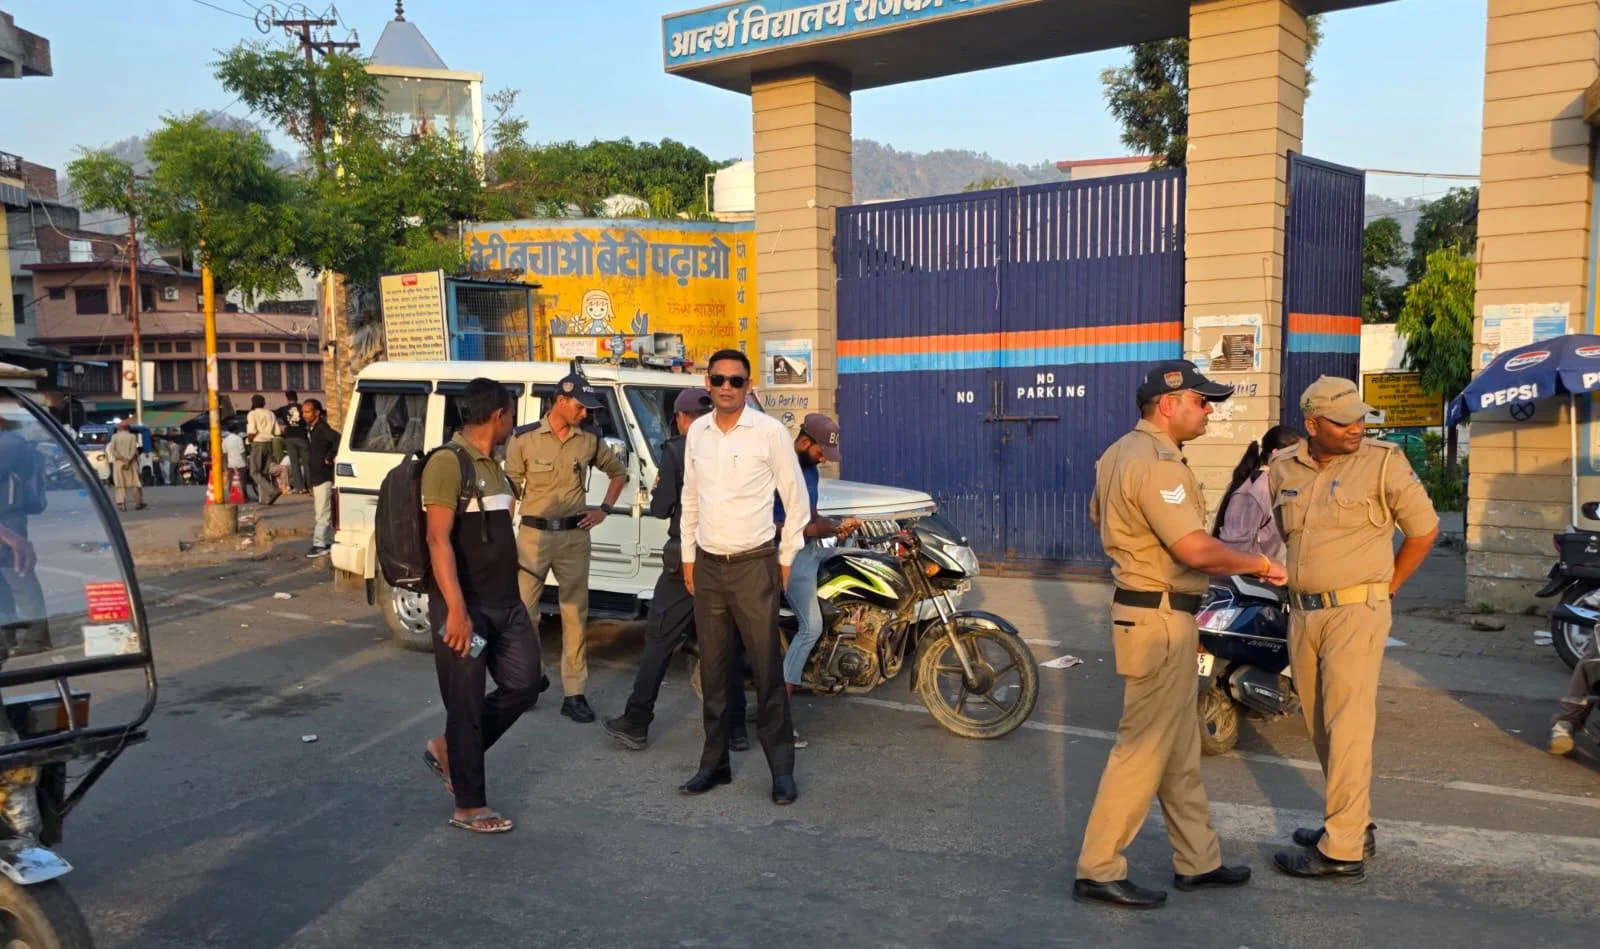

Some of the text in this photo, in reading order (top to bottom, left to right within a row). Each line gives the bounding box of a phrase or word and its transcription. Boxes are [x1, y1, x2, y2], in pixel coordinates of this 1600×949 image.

[668, 12, 740, 58] आदर्श
[741, 3, 848, 46] विद्यालय
[508, 232, 594, 276] बचाओ
[596, 231, 647, 277] बेटी
[650, 236, 731, 286] पढ़ाओ
[1036, 372, 1055, 384] NO
[956, 391, 974, 404] NO
[1017, 385, 1086, 400] PARKING
[1480, 383, 1538, 409] PEPSI
[764, 393, 809, 410] No Parking
